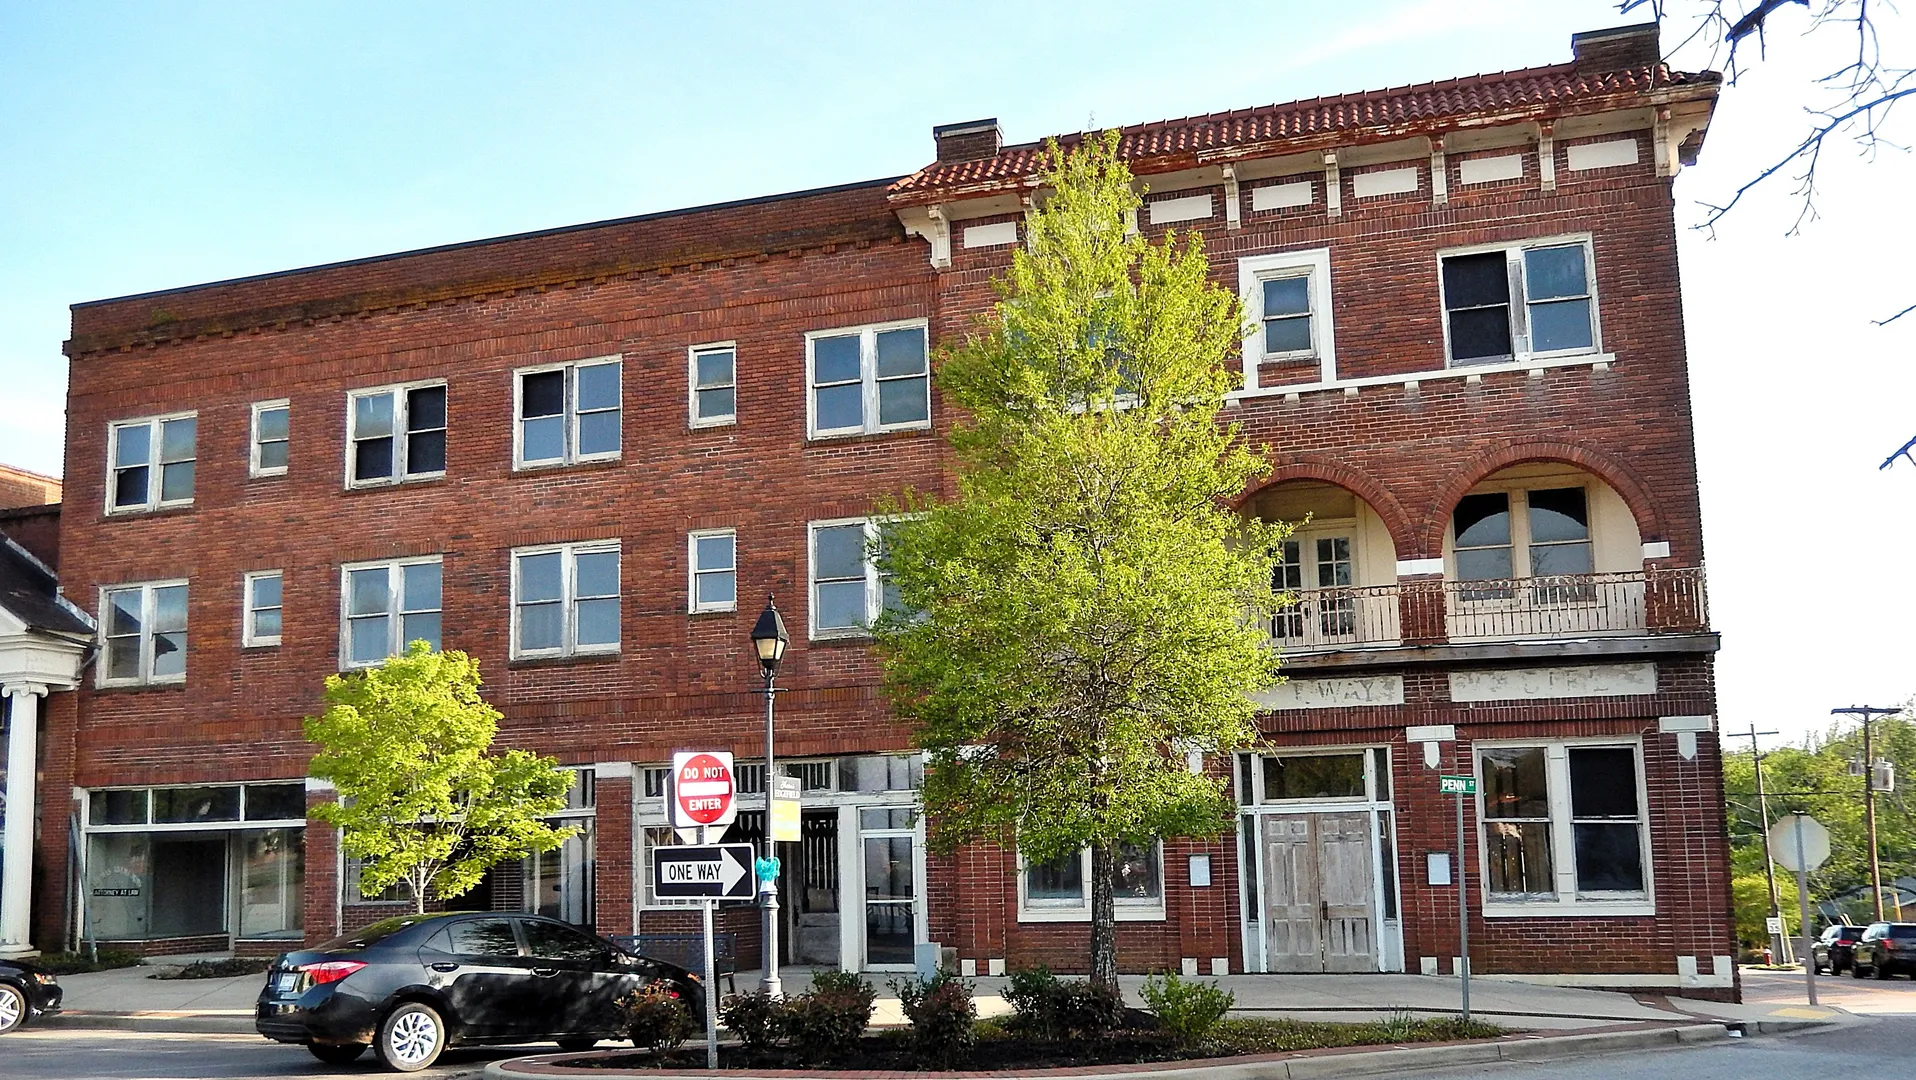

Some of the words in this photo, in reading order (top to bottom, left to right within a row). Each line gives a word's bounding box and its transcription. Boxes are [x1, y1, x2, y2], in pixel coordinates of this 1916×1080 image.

[684, 767, 698, 779] DO
[704, 767, 724, 778] NOT
[1441, 779, 1466, 791] PENN
[689, 798, 722, 811] ENTER
[668, 864, 693, 880] ONE
[697, 863, 721, 880] WAY
